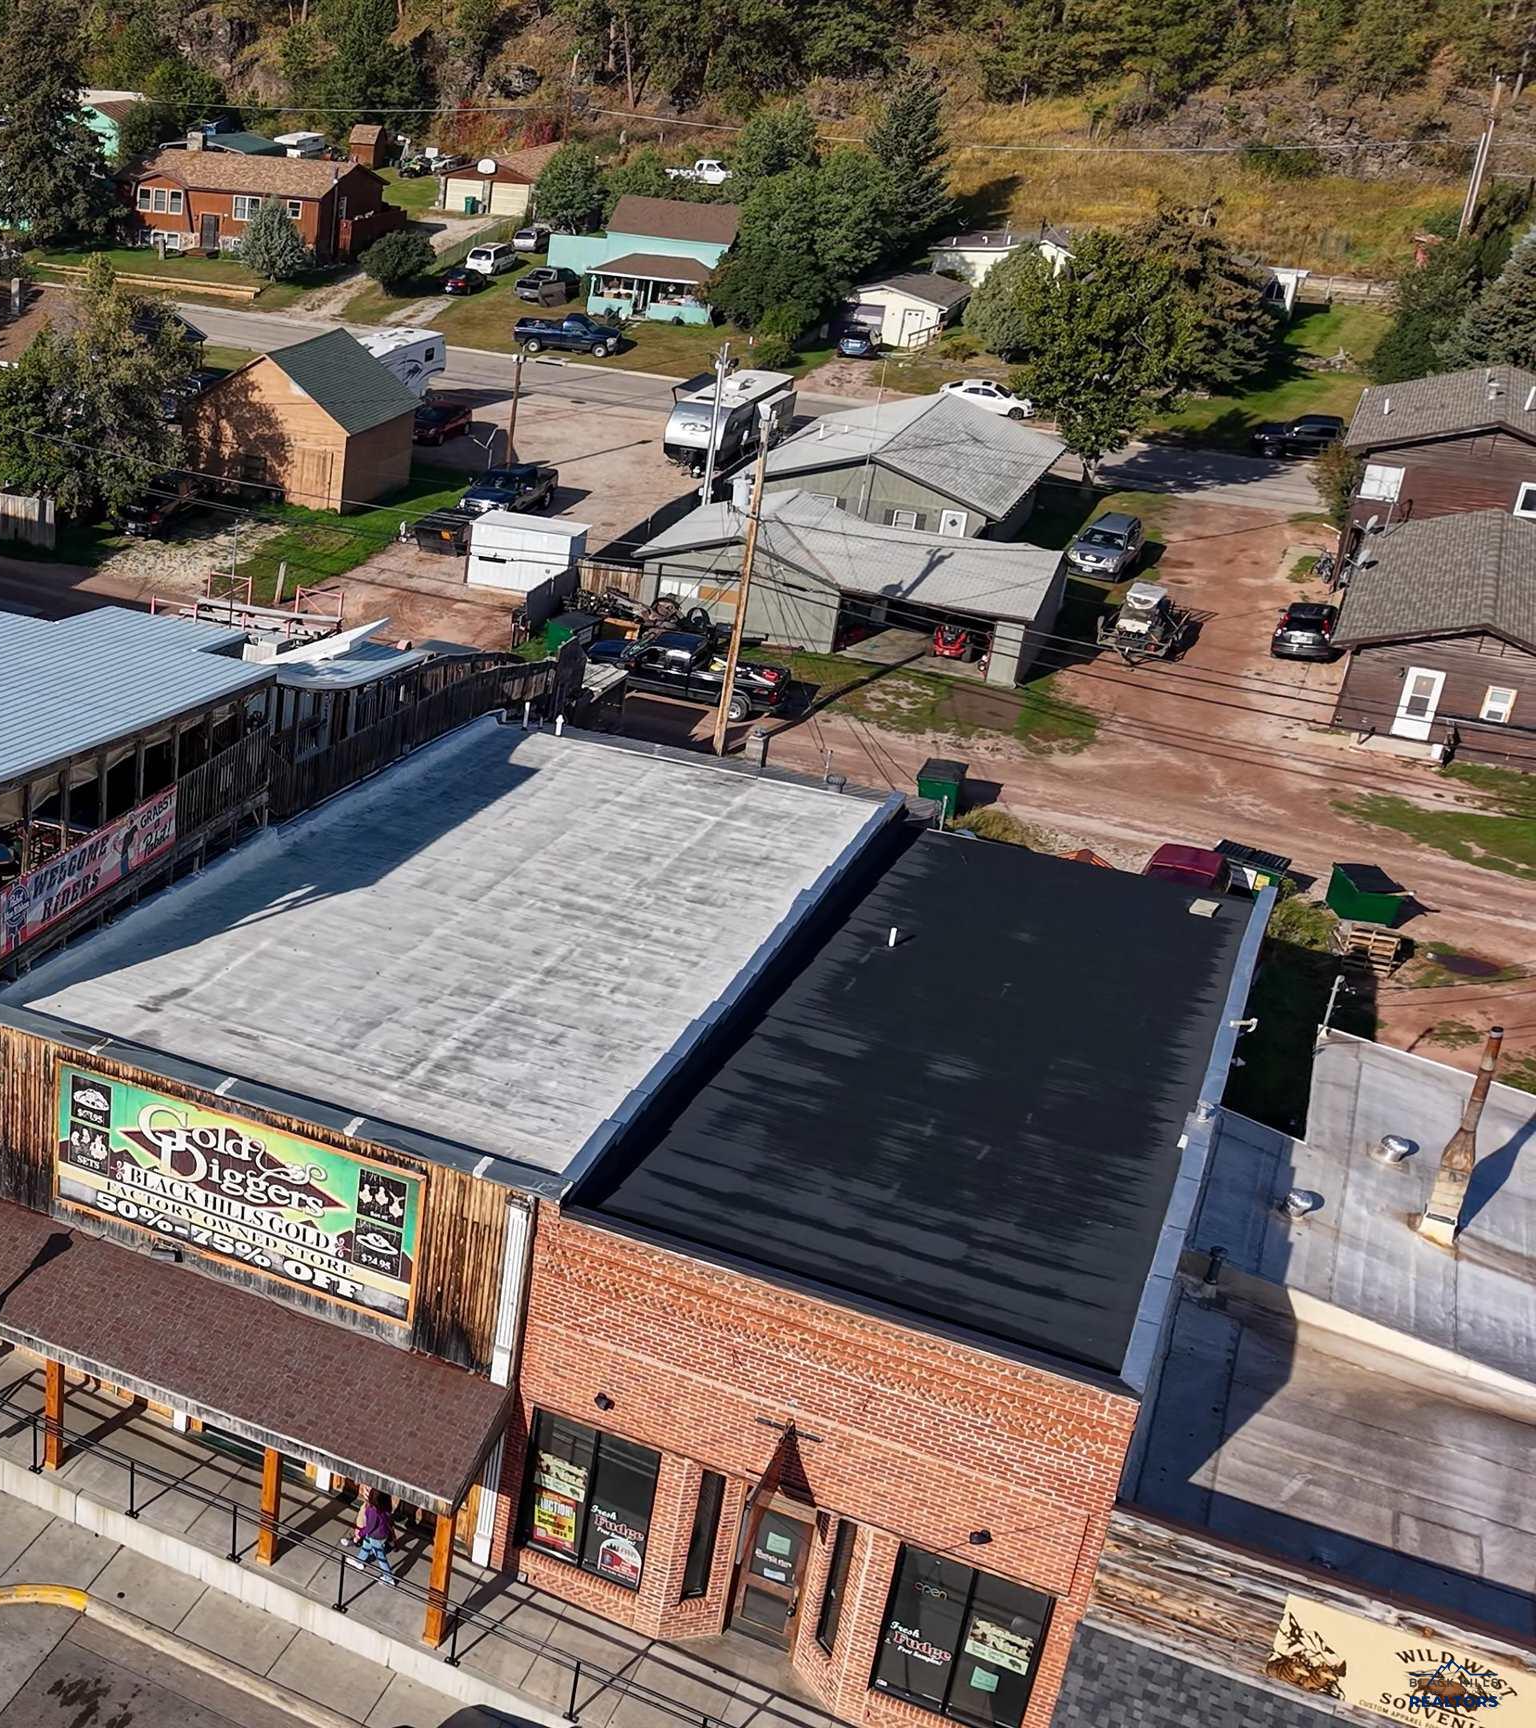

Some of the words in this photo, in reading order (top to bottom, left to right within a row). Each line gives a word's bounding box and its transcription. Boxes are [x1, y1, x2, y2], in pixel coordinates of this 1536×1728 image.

[32, 834, 110, 899] WELCOME
[41, 868, 102, 923] RIDERS
[137, 1103, 267, 1161] Gold
[76, 1154, 100, 1170] SETS
[152, 1131, 326, 1218] Diggers
[128, 1165, 204, 1207] BLACK
[203, 1190, 266, 1229] HILLS
[267, 1212, 331, 1250] GOLD
[95, 1191, 274, 1268] 50%-75%
[281, 1259, 364, 1299] OFF
[105, 1181, 201, 1219] FACTORY
[201, 1214, 280, 1253] OWNED
[282, 1242, 355, 1278] STORE
[590, 1504, 617, 1521] Fresh
[594, 1514, 645, 1542] Fudge
[890, 1620, 920, 1639] Fresh
[893, 1630, 952, 1662] Fudge
[1395, 1648, 1455, 1664] WILD
[1359, 1698, 1390, 1714] CUSTOM
